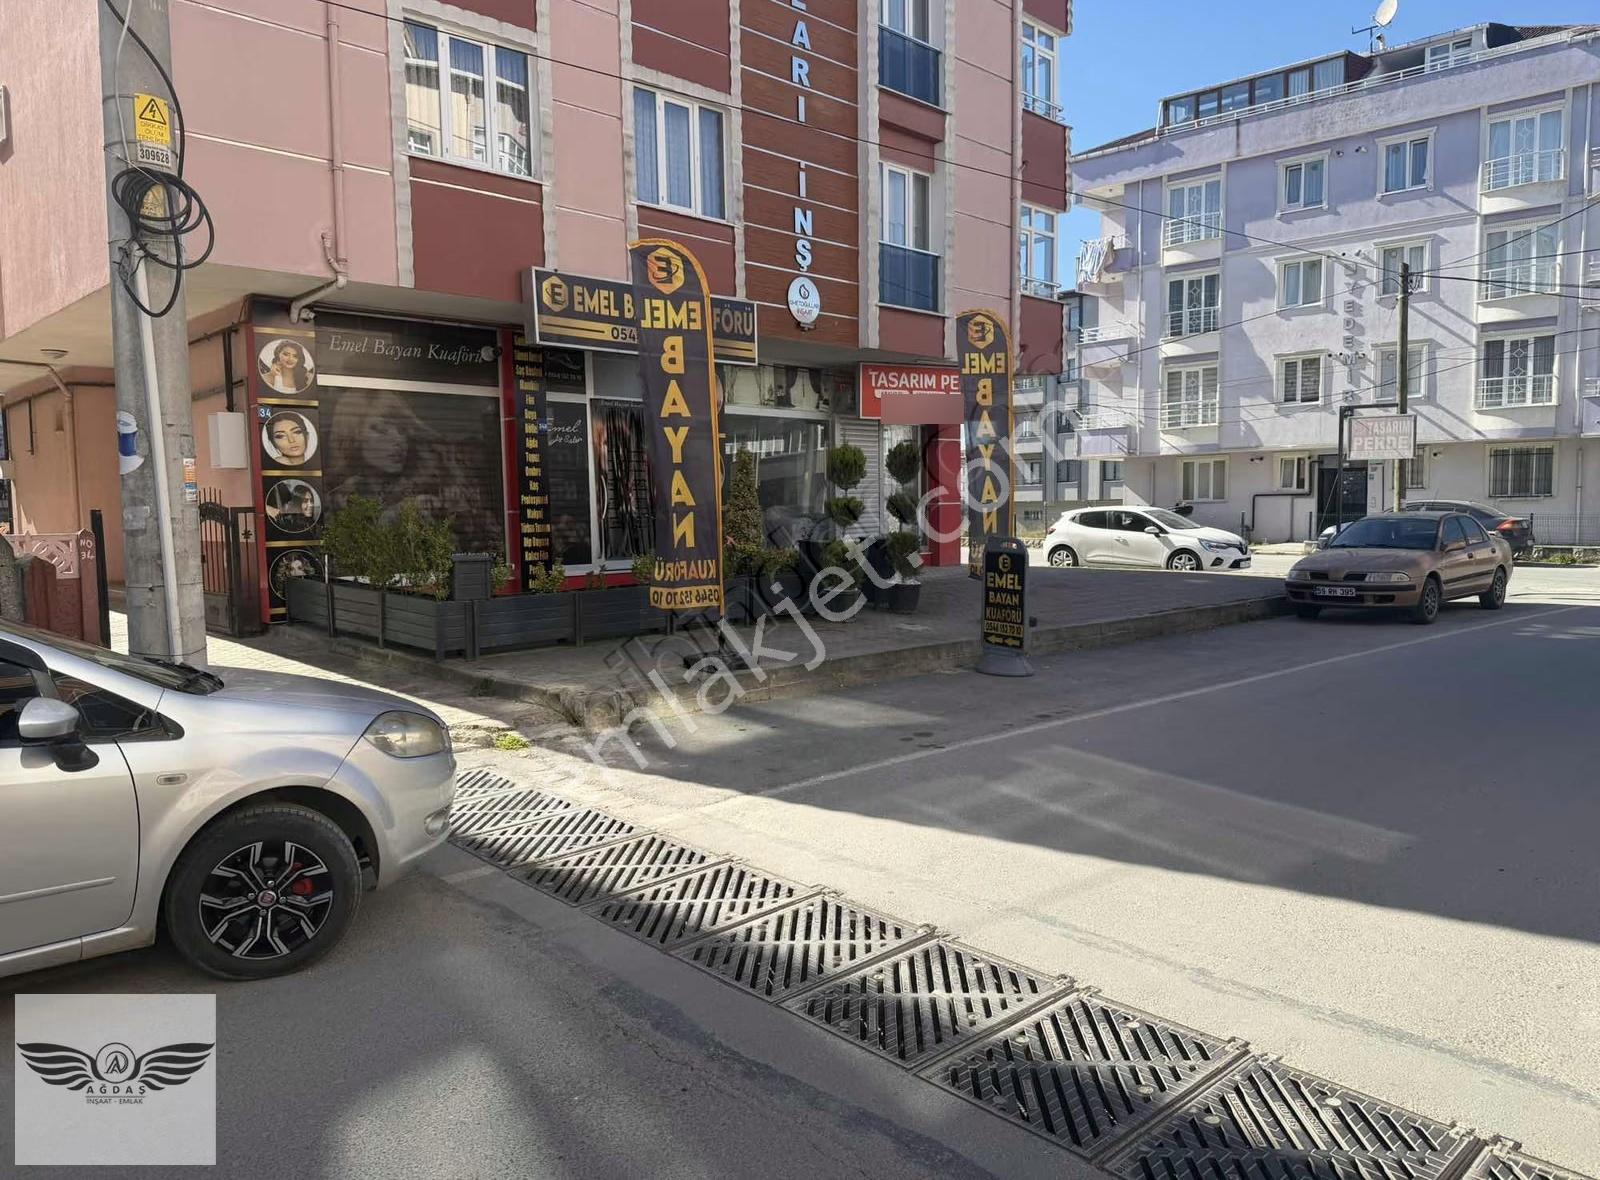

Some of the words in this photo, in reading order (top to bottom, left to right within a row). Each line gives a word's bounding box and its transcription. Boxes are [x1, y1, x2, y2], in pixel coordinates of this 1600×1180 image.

[139, 148, 170, 164] 309628
[794, 162, 813, 272] İNŞ
[574, 285, 619, 318] EMEL
[624, 290, 637, 322] B
[713, 303, 753, 336] FÖRÜ
[611, 325, 638, 343] 054
[329, 335, 367, 353] Emel
[374, 339, 422, 360] Bayan
[868, 371, 936, 389] TASARIM
[941, 375, 959, 390] PE
[259, 408, 271, 418] 34
[986, 572, 1021, 590] EMEL
[988, 591, 1019, 606] BAYAN
